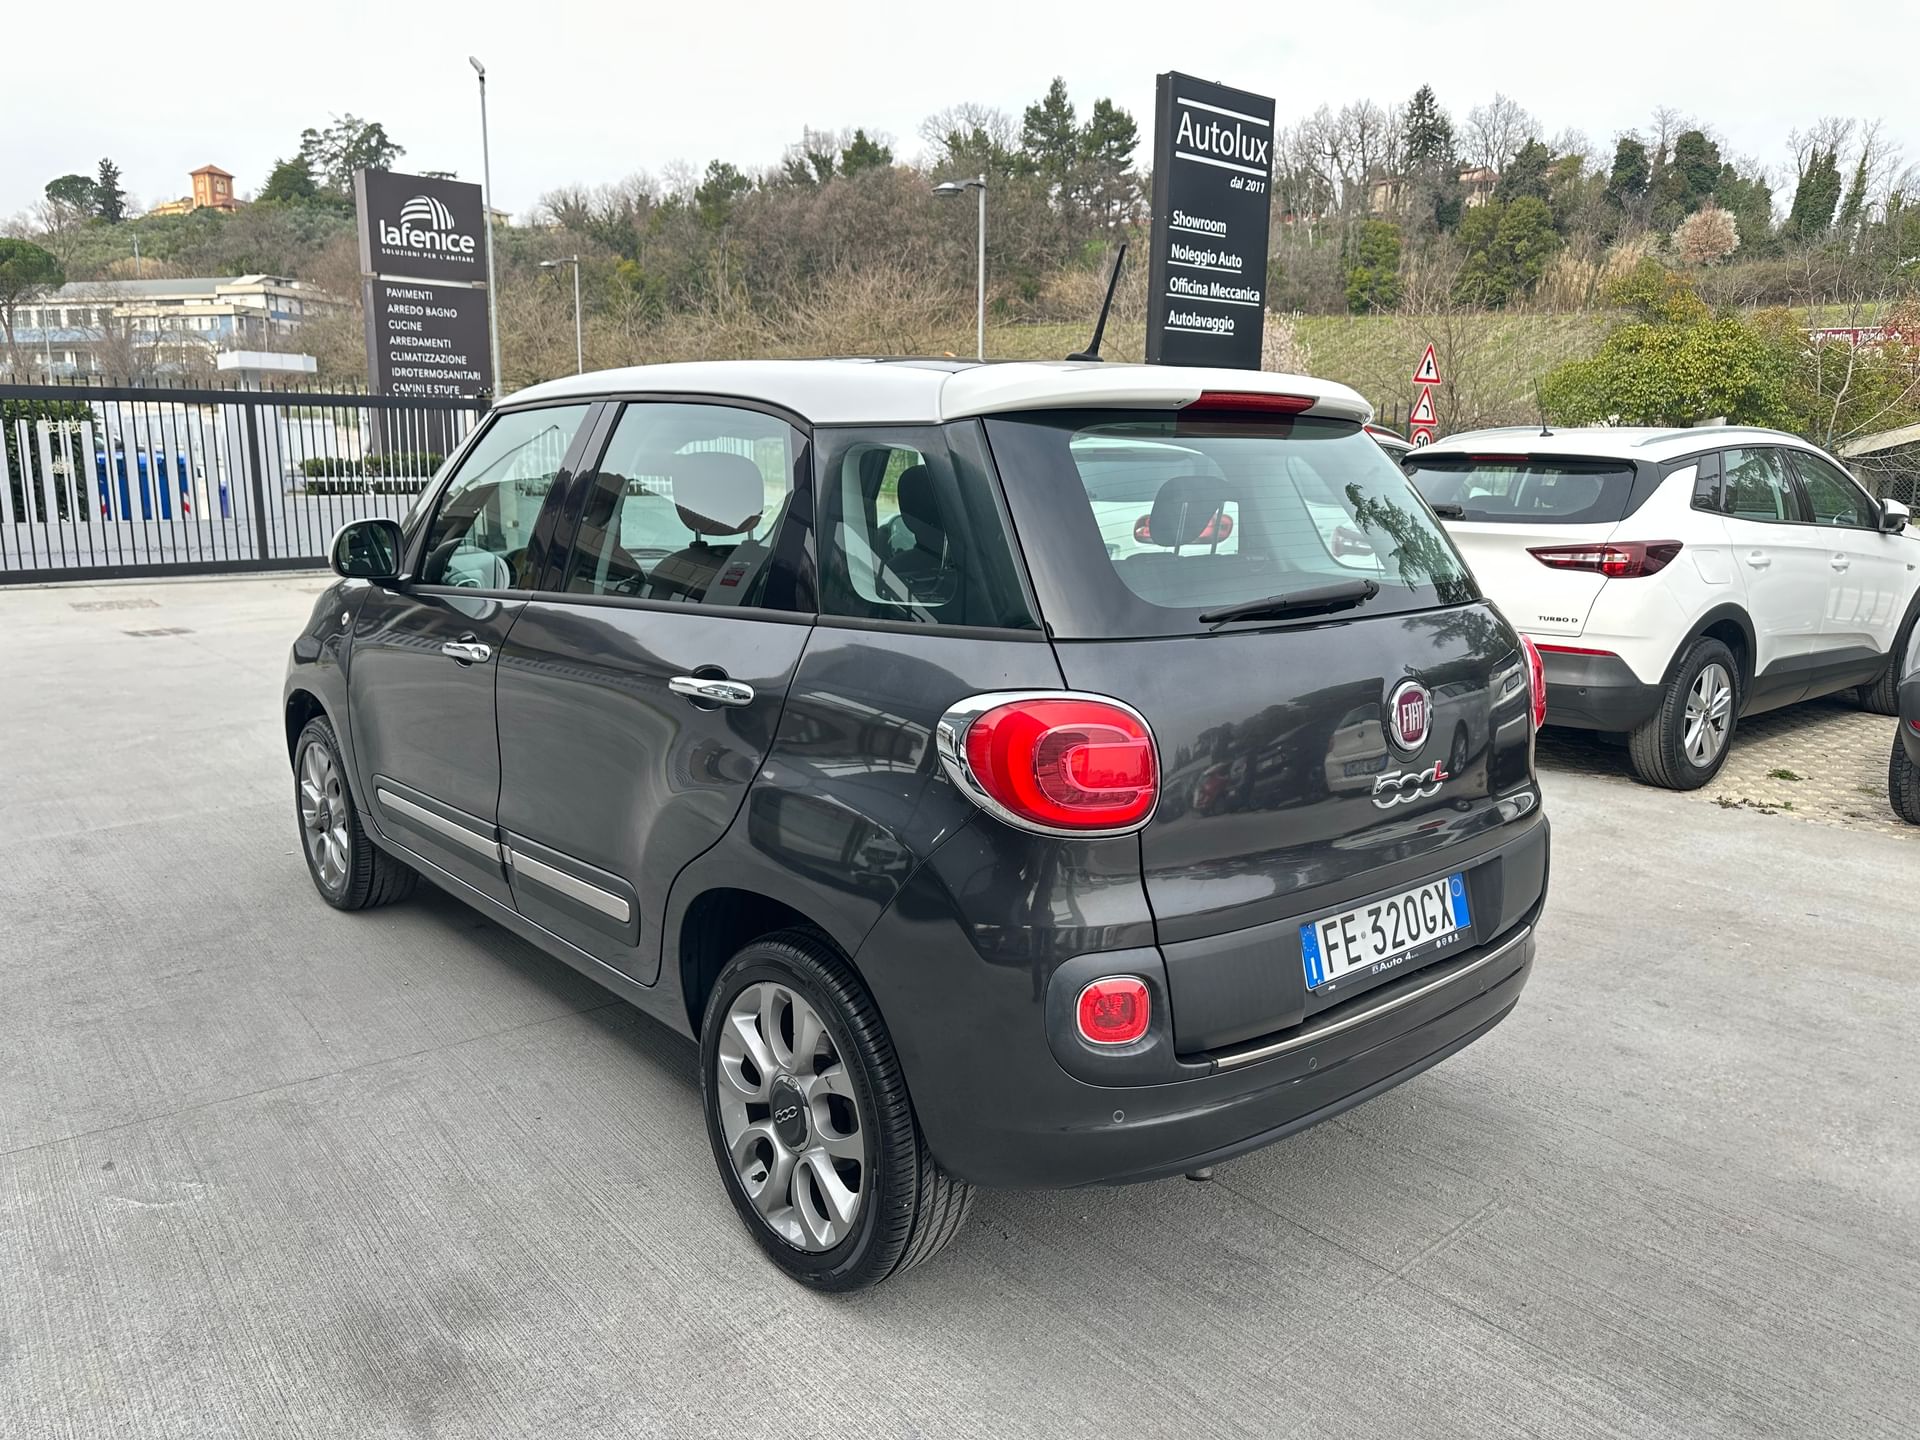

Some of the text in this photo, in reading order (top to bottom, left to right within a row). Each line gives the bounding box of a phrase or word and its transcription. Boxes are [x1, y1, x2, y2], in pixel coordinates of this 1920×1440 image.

[1176, 111, 1268, 165] Autolux
[1230, 176, 1265, 194] dal 2011
[1172, 210, 1227, 234] Showroom
[379, 219, 475, 254] lafenice
[381, 247, 475, 263] SOLUZIONI PER L'ABITARE
[1171, 243, 1242, 268] Noleggio Auto
[386, 287, 433, 300] PAVIMENTI
[1169, 276, 1260, 302] Officina Meccanica
[387, 303, 458, 319] ARREDO BAGNO
[388, 319, 423, 331] CUCINE
[1168, 309, 1235, 332] Autolavaggio
[389, 335, 452, 349] ARREDAMENTI
[390, 351, 467, 365] CLIMATIZZAZIONE
[391, 367, 481, 381] IDROTERMOSANITARI
[426, 383, 433, 394] E
[1416, 434, 1429, 449] 50
[1538, 615, 1569, 623] TURBO
[1402, 701, 1423, 733] FIAT
[1322, 913, 1362, 974] FE
[1367, 881, 1454, 956] 320GX
[1379, 957, 1402, 973] Auto
